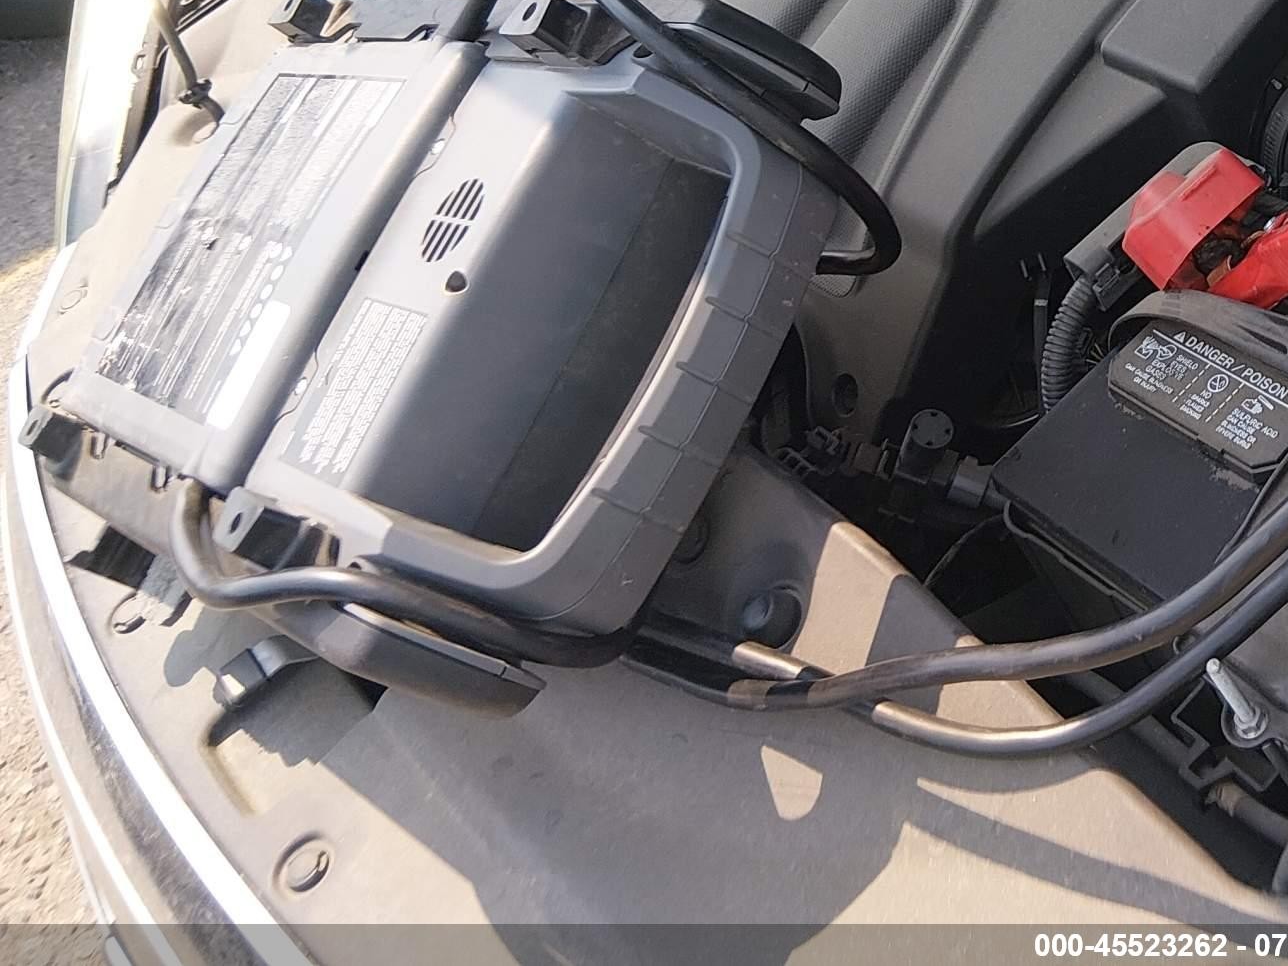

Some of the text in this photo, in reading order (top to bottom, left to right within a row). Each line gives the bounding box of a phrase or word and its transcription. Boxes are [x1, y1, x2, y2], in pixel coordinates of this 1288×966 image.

[1169, 360, 1187, 374] EYES
[1175, 352, 1199, 370] SHIELD
[1184, 335, 1235, 369] DANGER
[1240, 366, 1288, 400] POISON
[1144, 364, 1166, 380] GASES
[1199, 388, 1212, 399] NO
[1230, 407, 1278, 439] SULFURIC ACID
